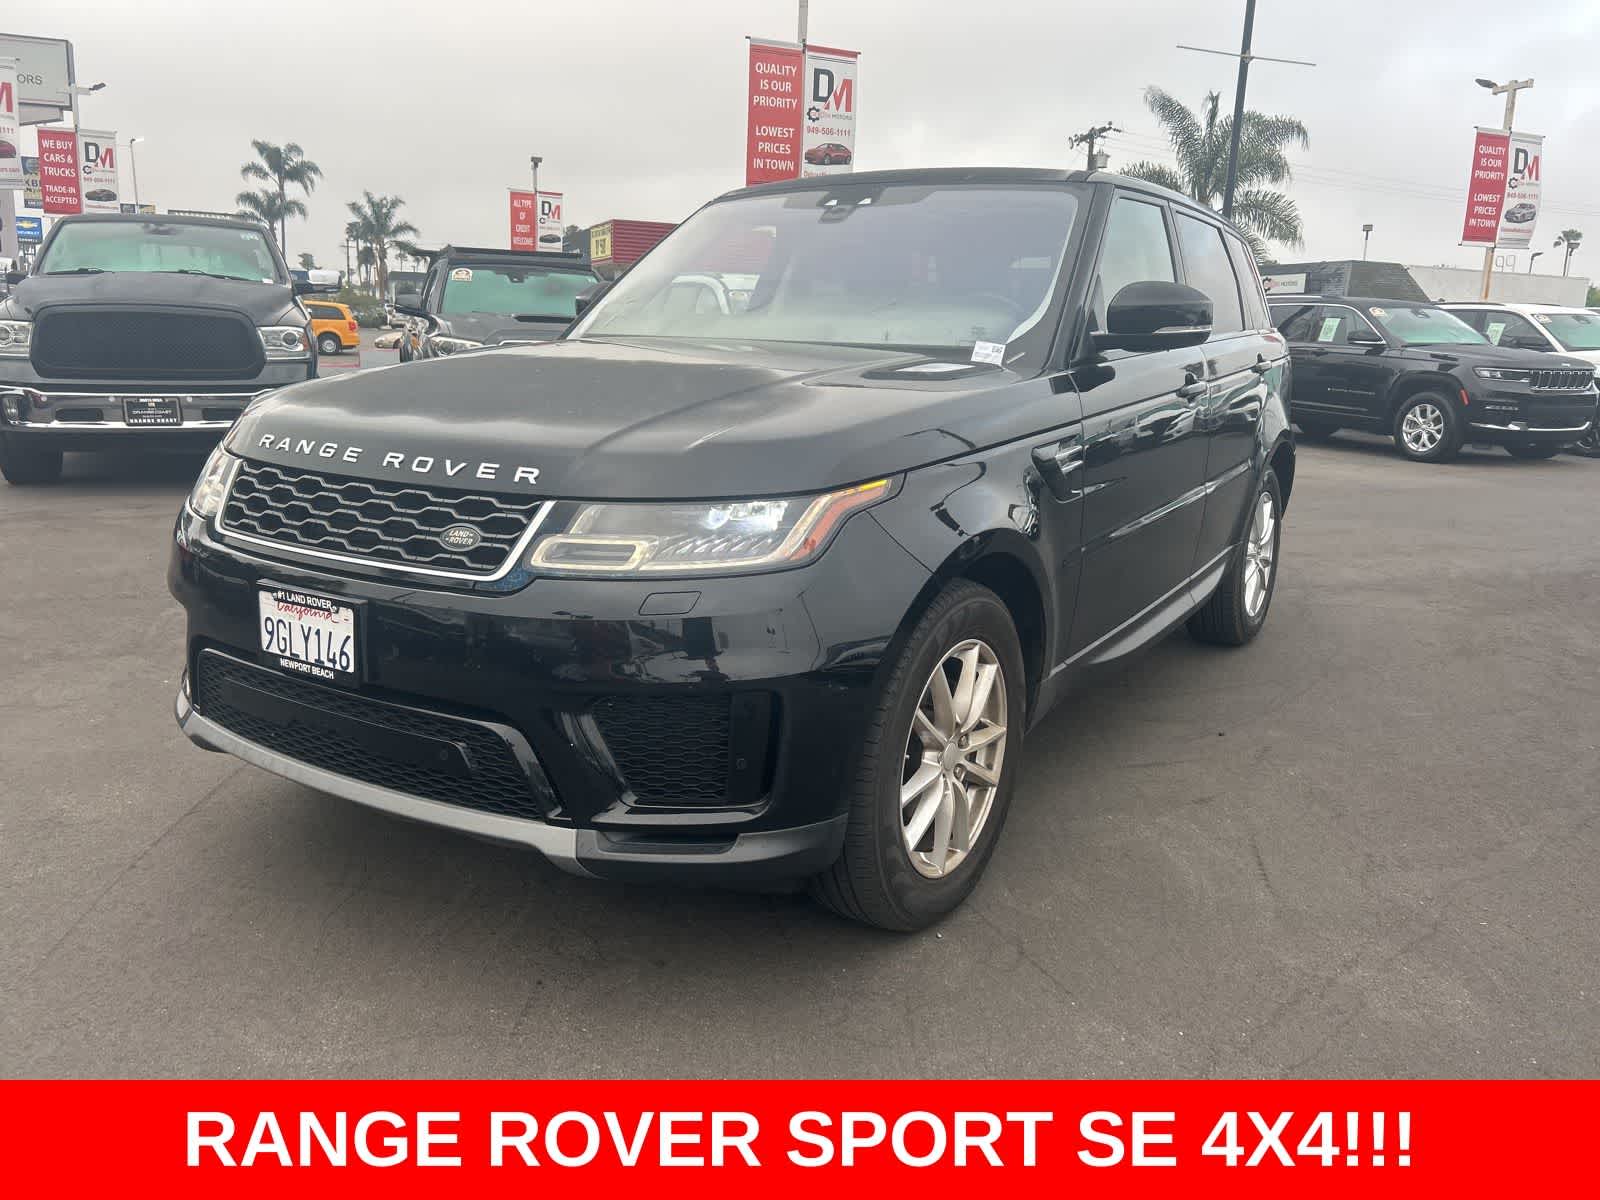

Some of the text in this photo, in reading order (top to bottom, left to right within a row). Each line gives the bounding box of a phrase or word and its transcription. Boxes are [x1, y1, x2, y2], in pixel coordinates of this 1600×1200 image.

[755, 62, 797, 76] QUALITY
[760, 79, 792, 92] IS OUR
[753, 95, 798, 110] PRIORITY
[755, 125, 795, 138] LOWEST
[807, 125, 852, 137] 949-506-1111
[42, 139, 73, 150] WE BUY
[758, 142, 791, 155] PRICES
[1479, 144, 1506, 155] QUALITY
[43, 153, 73, 164] CARS &
[1480, 158, 1502, 168] IS OUR
[753, 158, 794, 171] IN TOWN
[43, 166, 76, 177] TRUCKS
[1475, 169, 1505, 180] PRIORITY
[45, 184, 76, 194] TRADE-IN
[45, 195, 78, 205] ACCEPTED
[1474, 193, 1500, 204] LOWEST
[1474, 205, 1497, 216] PRICES
[1469, 218, 1496, 228] IN TOWN
[258, 434, 541, 484] RANGE ROVER
[449, 529, 470, 538] LAND
[449, 536, 474, 545] ROVER
[277, 591, 332, 610] #1 LAND ROVER
[264, 616, 351, 671] 9GLY146
[280, 657, 335, 680] NEWPORT BEACH
